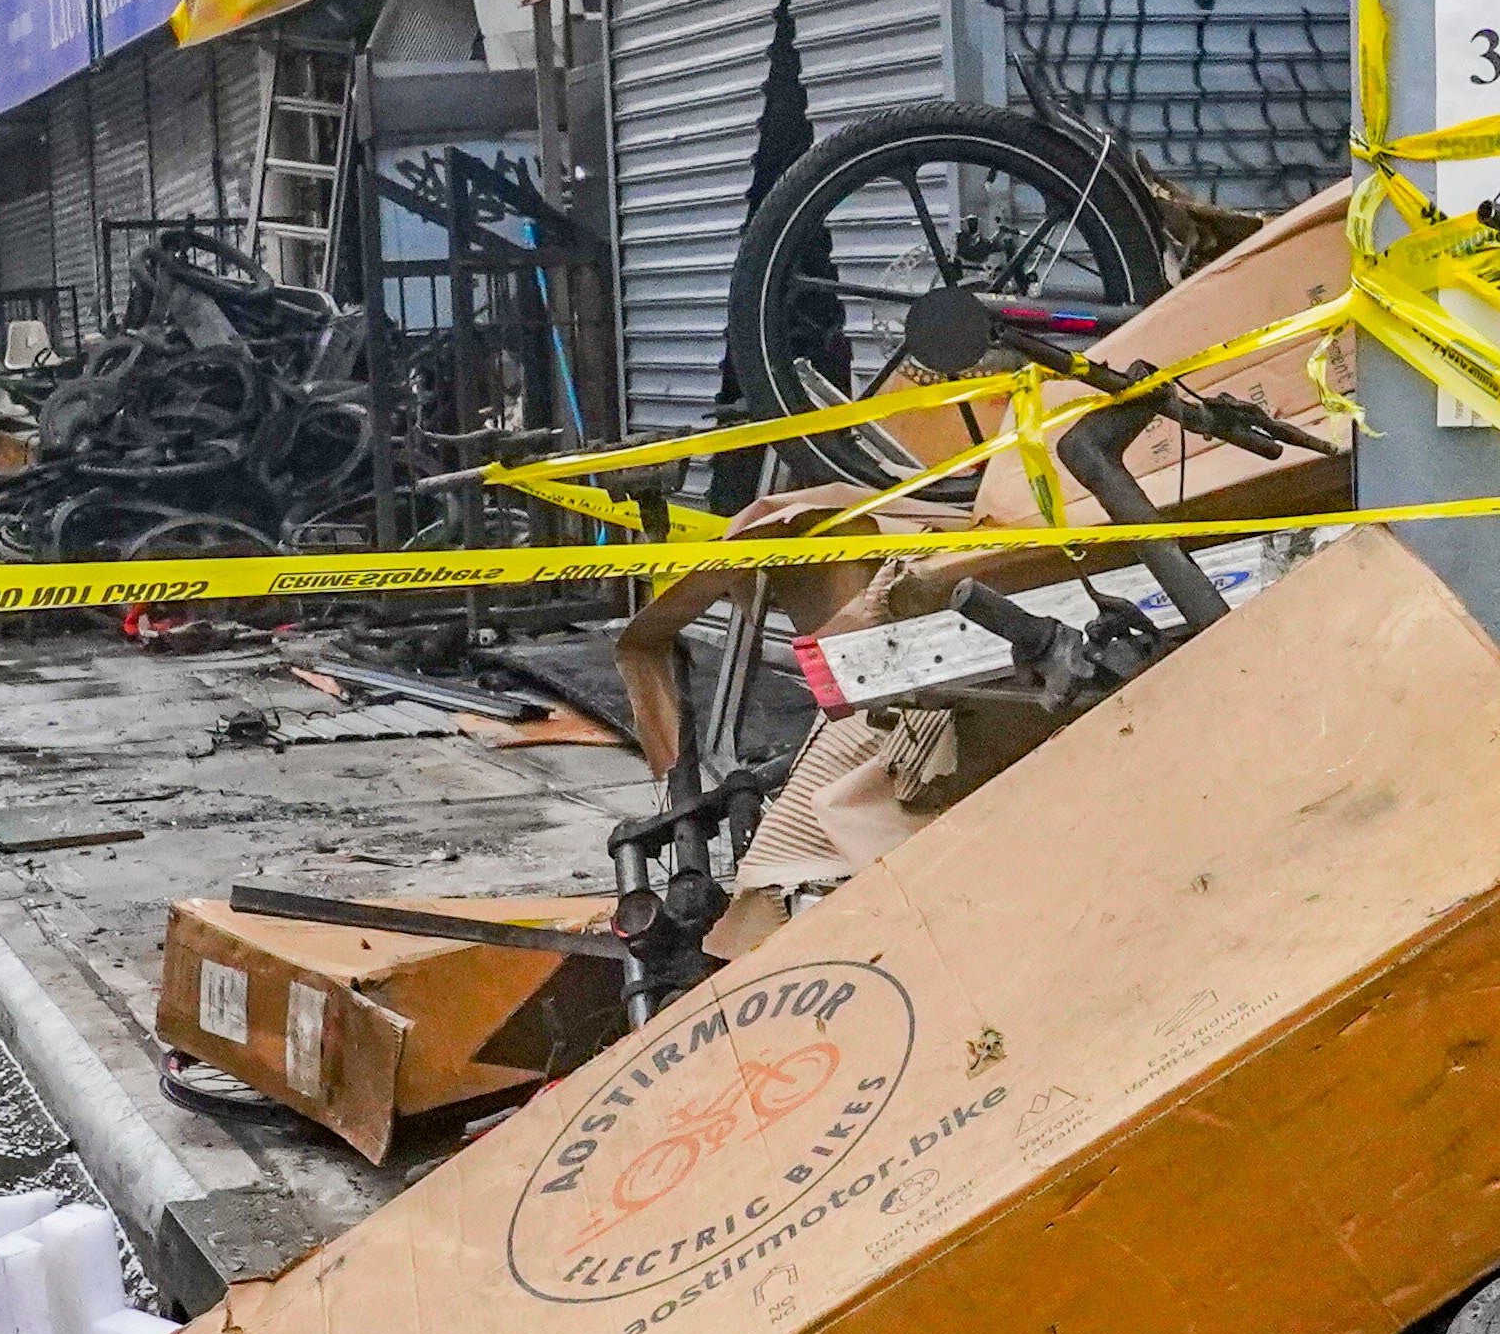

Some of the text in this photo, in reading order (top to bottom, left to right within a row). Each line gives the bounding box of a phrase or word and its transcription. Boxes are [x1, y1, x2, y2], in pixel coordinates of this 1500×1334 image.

[541, 978, 858, 1197] AOSTIRMOTOR
[563, 1073, 888, 1288] ELECTRIC BIKES
